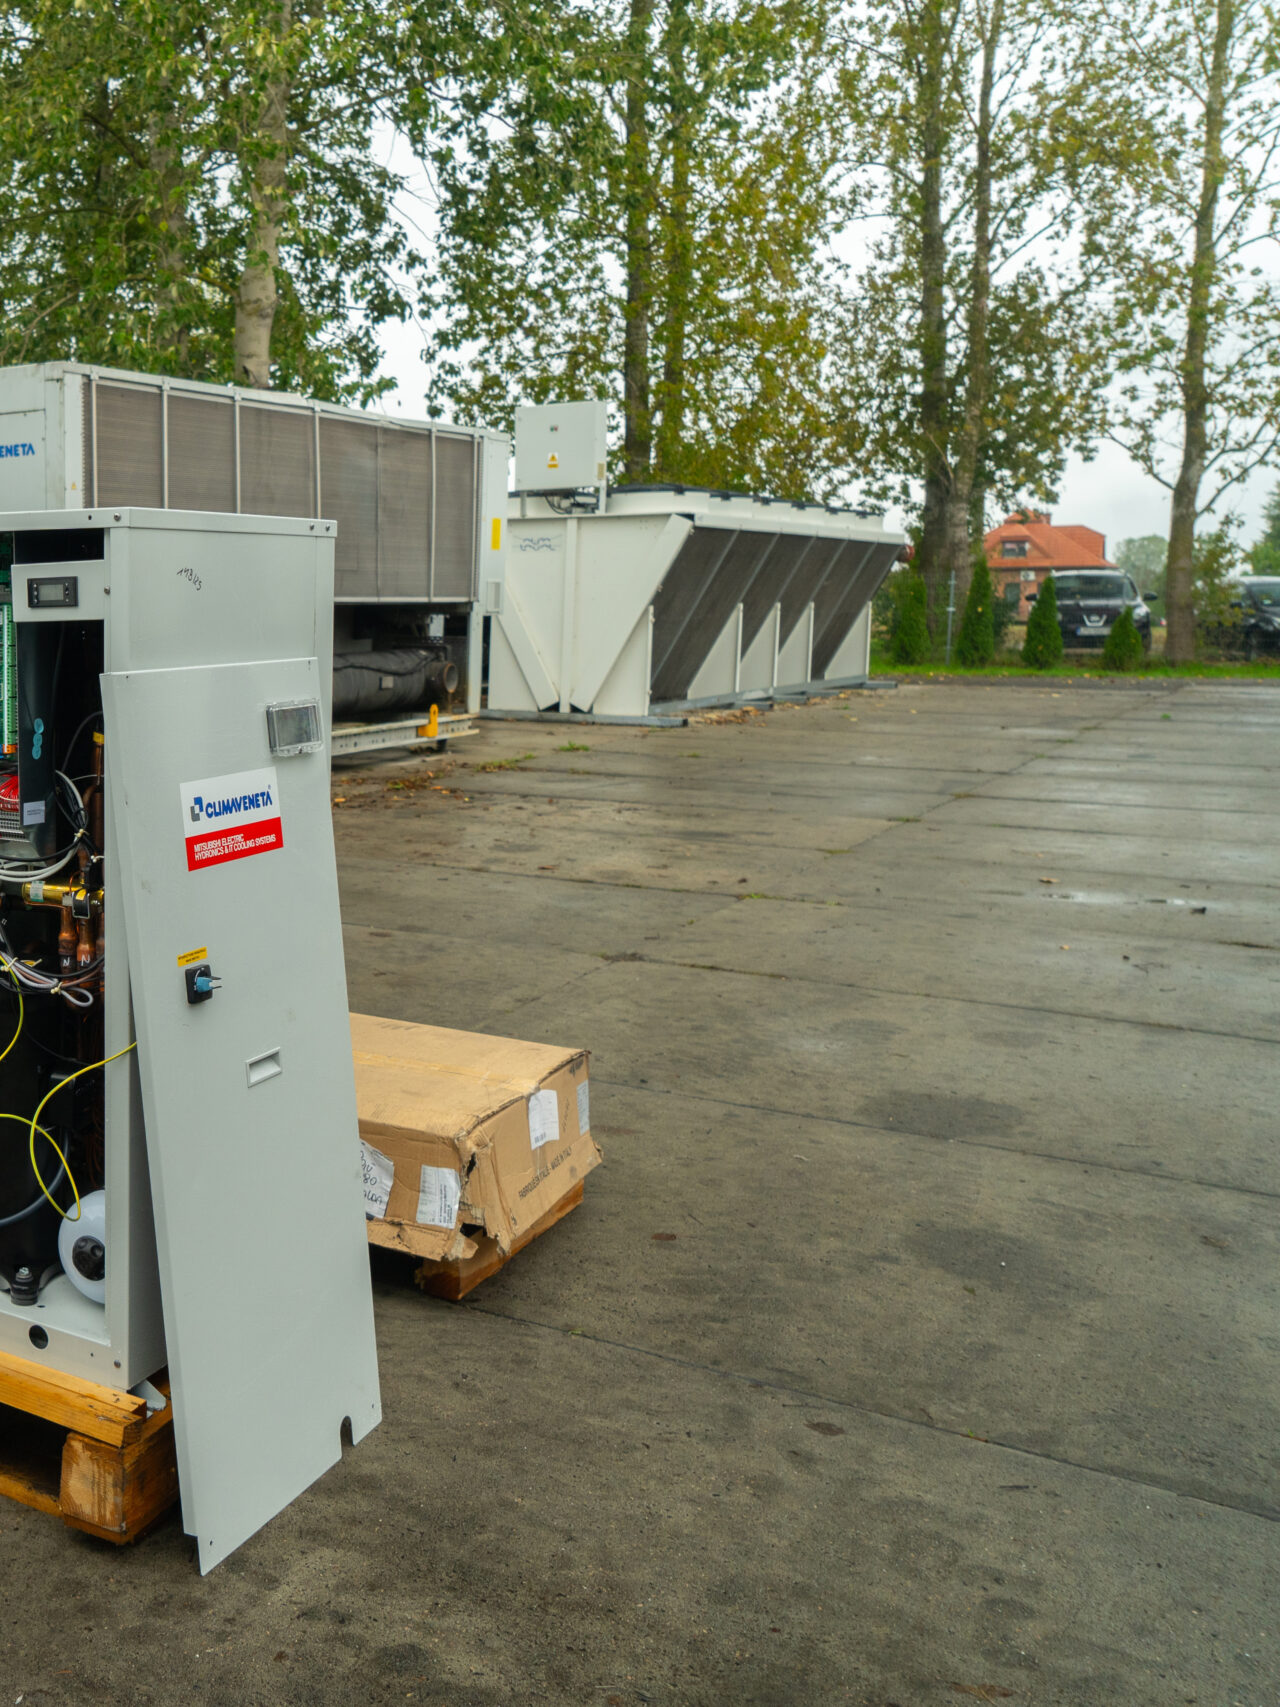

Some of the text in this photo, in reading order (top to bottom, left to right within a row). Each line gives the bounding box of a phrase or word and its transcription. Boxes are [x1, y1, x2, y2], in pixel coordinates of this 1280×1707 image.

[205, 791, 272, 818] CLIMAVENETA
[194, 846, 224, 861] HYDRONICS
[234, 839, 255, 852] COOLING
[255, 834, 276, 846] SYSTEMS
[221, 834, 244, 847] ELECTRIC
